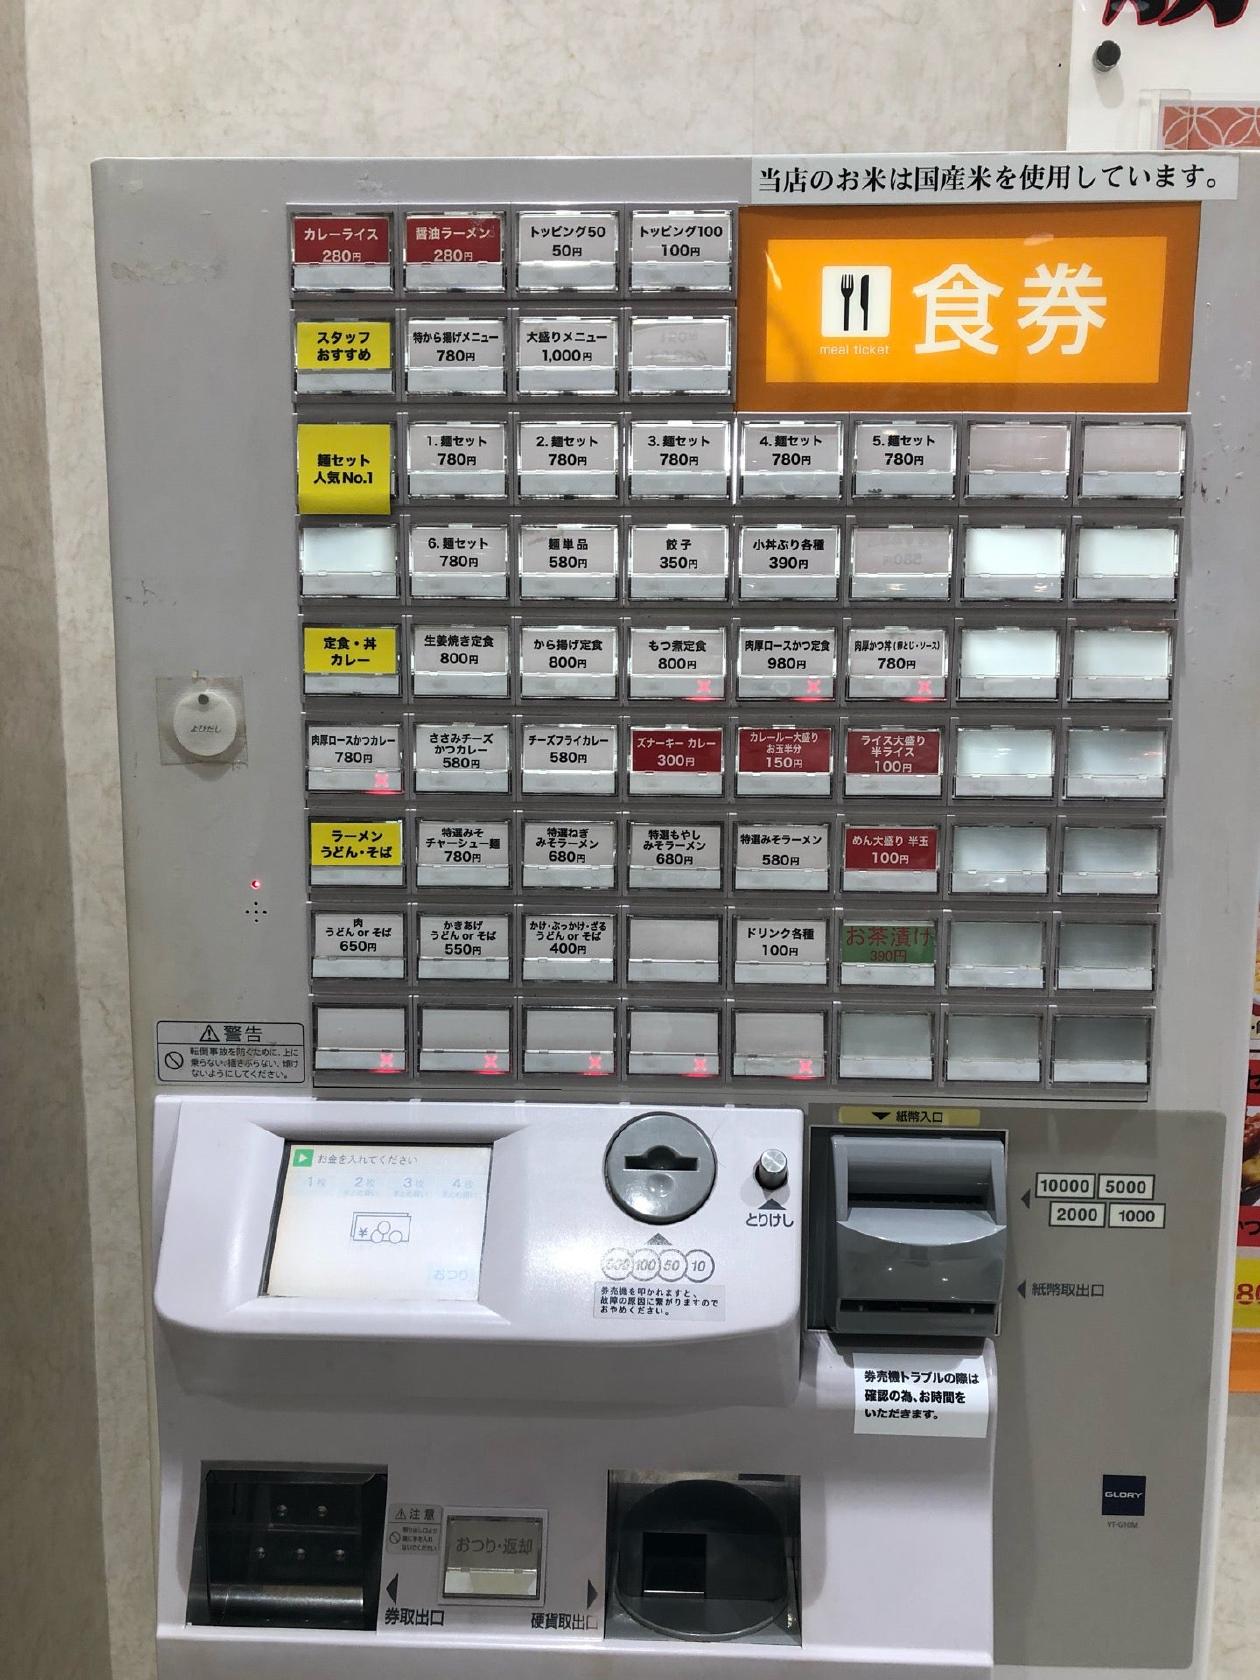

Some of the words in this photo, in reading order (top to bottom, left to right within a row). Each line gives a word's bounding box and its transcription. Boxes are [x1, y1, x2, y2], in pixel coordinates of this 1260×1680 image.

[758, 163, 1218, 194] 当店のお米は国産米を使用しています。
[304, 227, 379, 241] カレーライス
[416, 227, 490, 240] 醤油ラーメン
[529, 226, 606, 238] トッピング50
[640, 226, 723, 238] トッピング100
[322, 249, 361, 262] 280円
[434, 249, 473, 262] 280円
[552, 244, 582, 257] 50円
[661, 244, 700, 257] 100円
[912, 263, 1107, 356] 食券
[317, 331, 370, 345] スタッフ
[412, 331, 499, 343] 特から揚げメニュー
[526, 331, 607, 343] 大盛りメニュー
[317, 348, 371, 362] おすすめ
[436, 349, 475, 362] 780円
[819, 344, 849, 355] meal
[852, 344, 889, 355] ticket
[541, 350, 592, 363] 1,000円
[317, 454, 370, 467] 麺セット
[437, 454, 476, 466] 780円
[549, 454, 587, 466] 780円
[660, 454, 699, 466] 780円
[772, 454, 811, 466] 780円
[884, 454, 924, 466] 780円
[548, 538, 588, 551] 麺単品
[666, 539, 692, 551] 餃子
[753, 539, 824, 551] 小丼ぶり各種
[440, 556, 478, 568] 780円
[549, 556, 587, 568] 580円
[660, 557, 698, 569] 350円
[769, 557, 808, 570] 390円
[323, 637, 377, 650] 定食・丼
[424, 635, 494, 647] 生姜焼き定食
[533, 639, 603, 651] から揚げ定食
[648, 640, 707, 652] もつ煮定食
[745, 640, 830, 652] 肉厚ロースかつ定食
[331, 654, 370, 666] カレー
[440, 653, 479, 665] 800円
[549, 656, 587, 669] 800円
[658, 657, 697, 670] 800円
[767, 657, 806, 670] 980円
[878, 657, 916, 670] 780円
[311, 734, 395, 746] 肉厚ロースかつカレー
[429, 732, 493, 744] ささみチーズ
[528, 735, 609, 747] チーズフライカレー
[750, 731, 818, 743] カレールー大盛り
[861, 735, 925, 746] ライス大盛り
[434, 744, 487, 755] かつカレー
[688, 738, 716, 749] カレー
[766, 744, 802, 754] お玉半分
[871, 746, 915, 757] 半ライス
[335, 752, 373, 764] 780円
[443, 757, 480, 769] 580円
[550, 752, 587, 764] 580円
[657, 754, 695, 767] 300円
[766, 757, 803, 768] 150円
[874, 761, 912, 773] 100円
[331, 830, 383, 842] ラーメン
[441, 828, 484, 838] 特選みそ
[547, 827, 589, 838] 特選ねぎ
[648, 829, 701, 841] 特選もやし
[425, 838, 500, 849] チャーシュー麺
[535, 838, 599, 849] みそラーメン
[643, 840, 706, 851] みそラーメン
[740, 834, 822, 845] 特選みそラーメン
[852, 836, 903, 847] めん大盛り
[907, 835, 929, 847] 半玉
[321, 846, 392, 859] うどん・そば
[444, 851, 481, 863] 780円
[549, 851, 586, 863] 680円
[871, 852, 909, 865] 100円
[656, 853, 693, 865] 680円
[762, 854, 800, 866] 580円
[353, 918, 363, 928] 肉
[443, 921, 483, 930] かきあげ
[325, 927, 356, 937] うどん
[357, 929, 369, 937] or
[372, 927, 392, 937] そば
[430, 931, 459, 941] うどん
[462, 933, 474, 941] or
[477, 931, 496, 941] そば
[536, 931, 564, 941] うどん
[567, 933, 579, 941] or
[582, 931, 601, 941] そば
[747, 928, 814, 940] ドリンク各種
[847, 926, 929, 947] お茶漬け
[339, 941, 377, 952] 650円
[444, 943, 481, 955] 550円
[549, 943, 586, 955] 400円
[762, 945, 798, 957] 100円
[224, 1025, 262, 1042] 警告
[896, 1111, 943, 1124] 紙幣入口
[317, 1154, 417, 1165] お金を入れてください
[1040, 1179, 1090, 1194] 10000
[1105, 1180, 1147, 1194] 5000
[746, 1213, 794, 1228] とりけし
[1057, 1208, 1098, 1222] 2000
[1118, 1209, 1155, 1223] 1000
[636, 1259, 657, 1271] 100
[663, 1260, 680, 1271] 50
[691, 1260, 706, 1271] 10
[1031, 1283, 1104, 1297] 紙幣取出口
[600, 1306, 670, 1316] おやめください。
[864, 1370, 980, 1384] 券売機トラブルの際は
[864, 1389, 966, 1404] 確認の為、お時間を
[865, 1409, 939, 1420] いただきます。
[1104, 1491, 1143, 1499] GLORY
[409, 1508, 435, 1521] 注意
[456, 1538, 533, 1554] おつり・返却
[385, 1608, 445, 1626] 券取出口
[531, 1612, 599, 1630] 硬貨取出口
